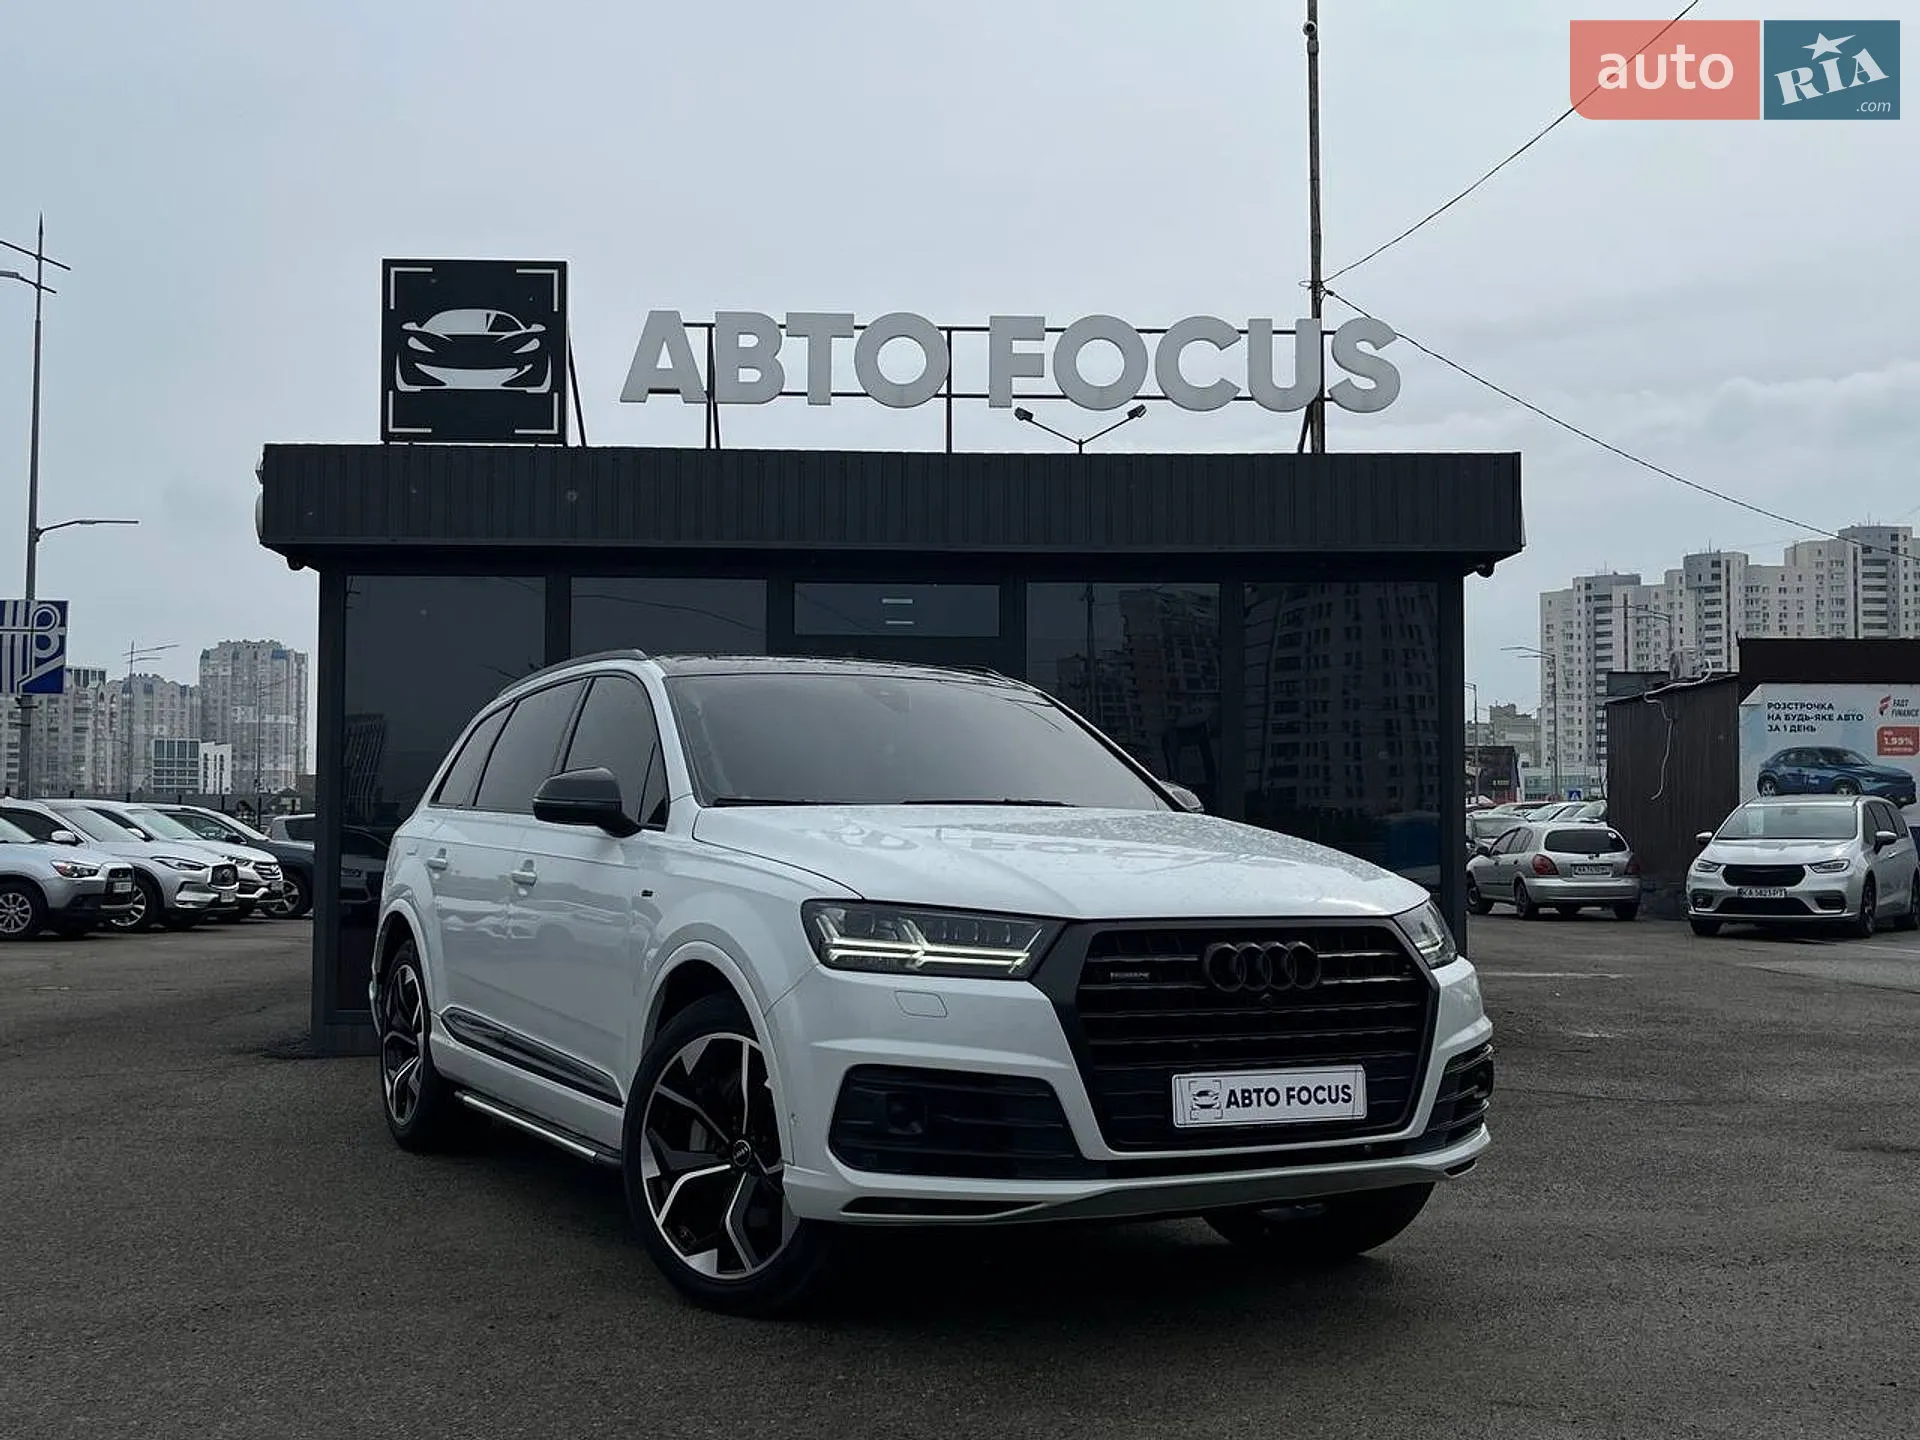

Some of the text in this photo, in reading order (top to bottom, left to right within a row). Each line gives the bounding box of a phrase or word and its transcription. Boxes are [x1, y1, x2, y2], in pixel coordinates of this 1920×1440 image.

[619, 310, 1402, 412] АВТО FOCUS
[1767, 702, 1834, 710] РОЗСТРОЧКА
[1784, 714, 1834, 722] БУДЬ-ЯКЕ
[1836, 713, 1864, 721] АВТО
[1767, 724, 1781, 732] ЗА
[1789, 724, 1817, 733] ДЕНЬ
[1225, 1084, 1353, 1109] АВТО FOCUS
